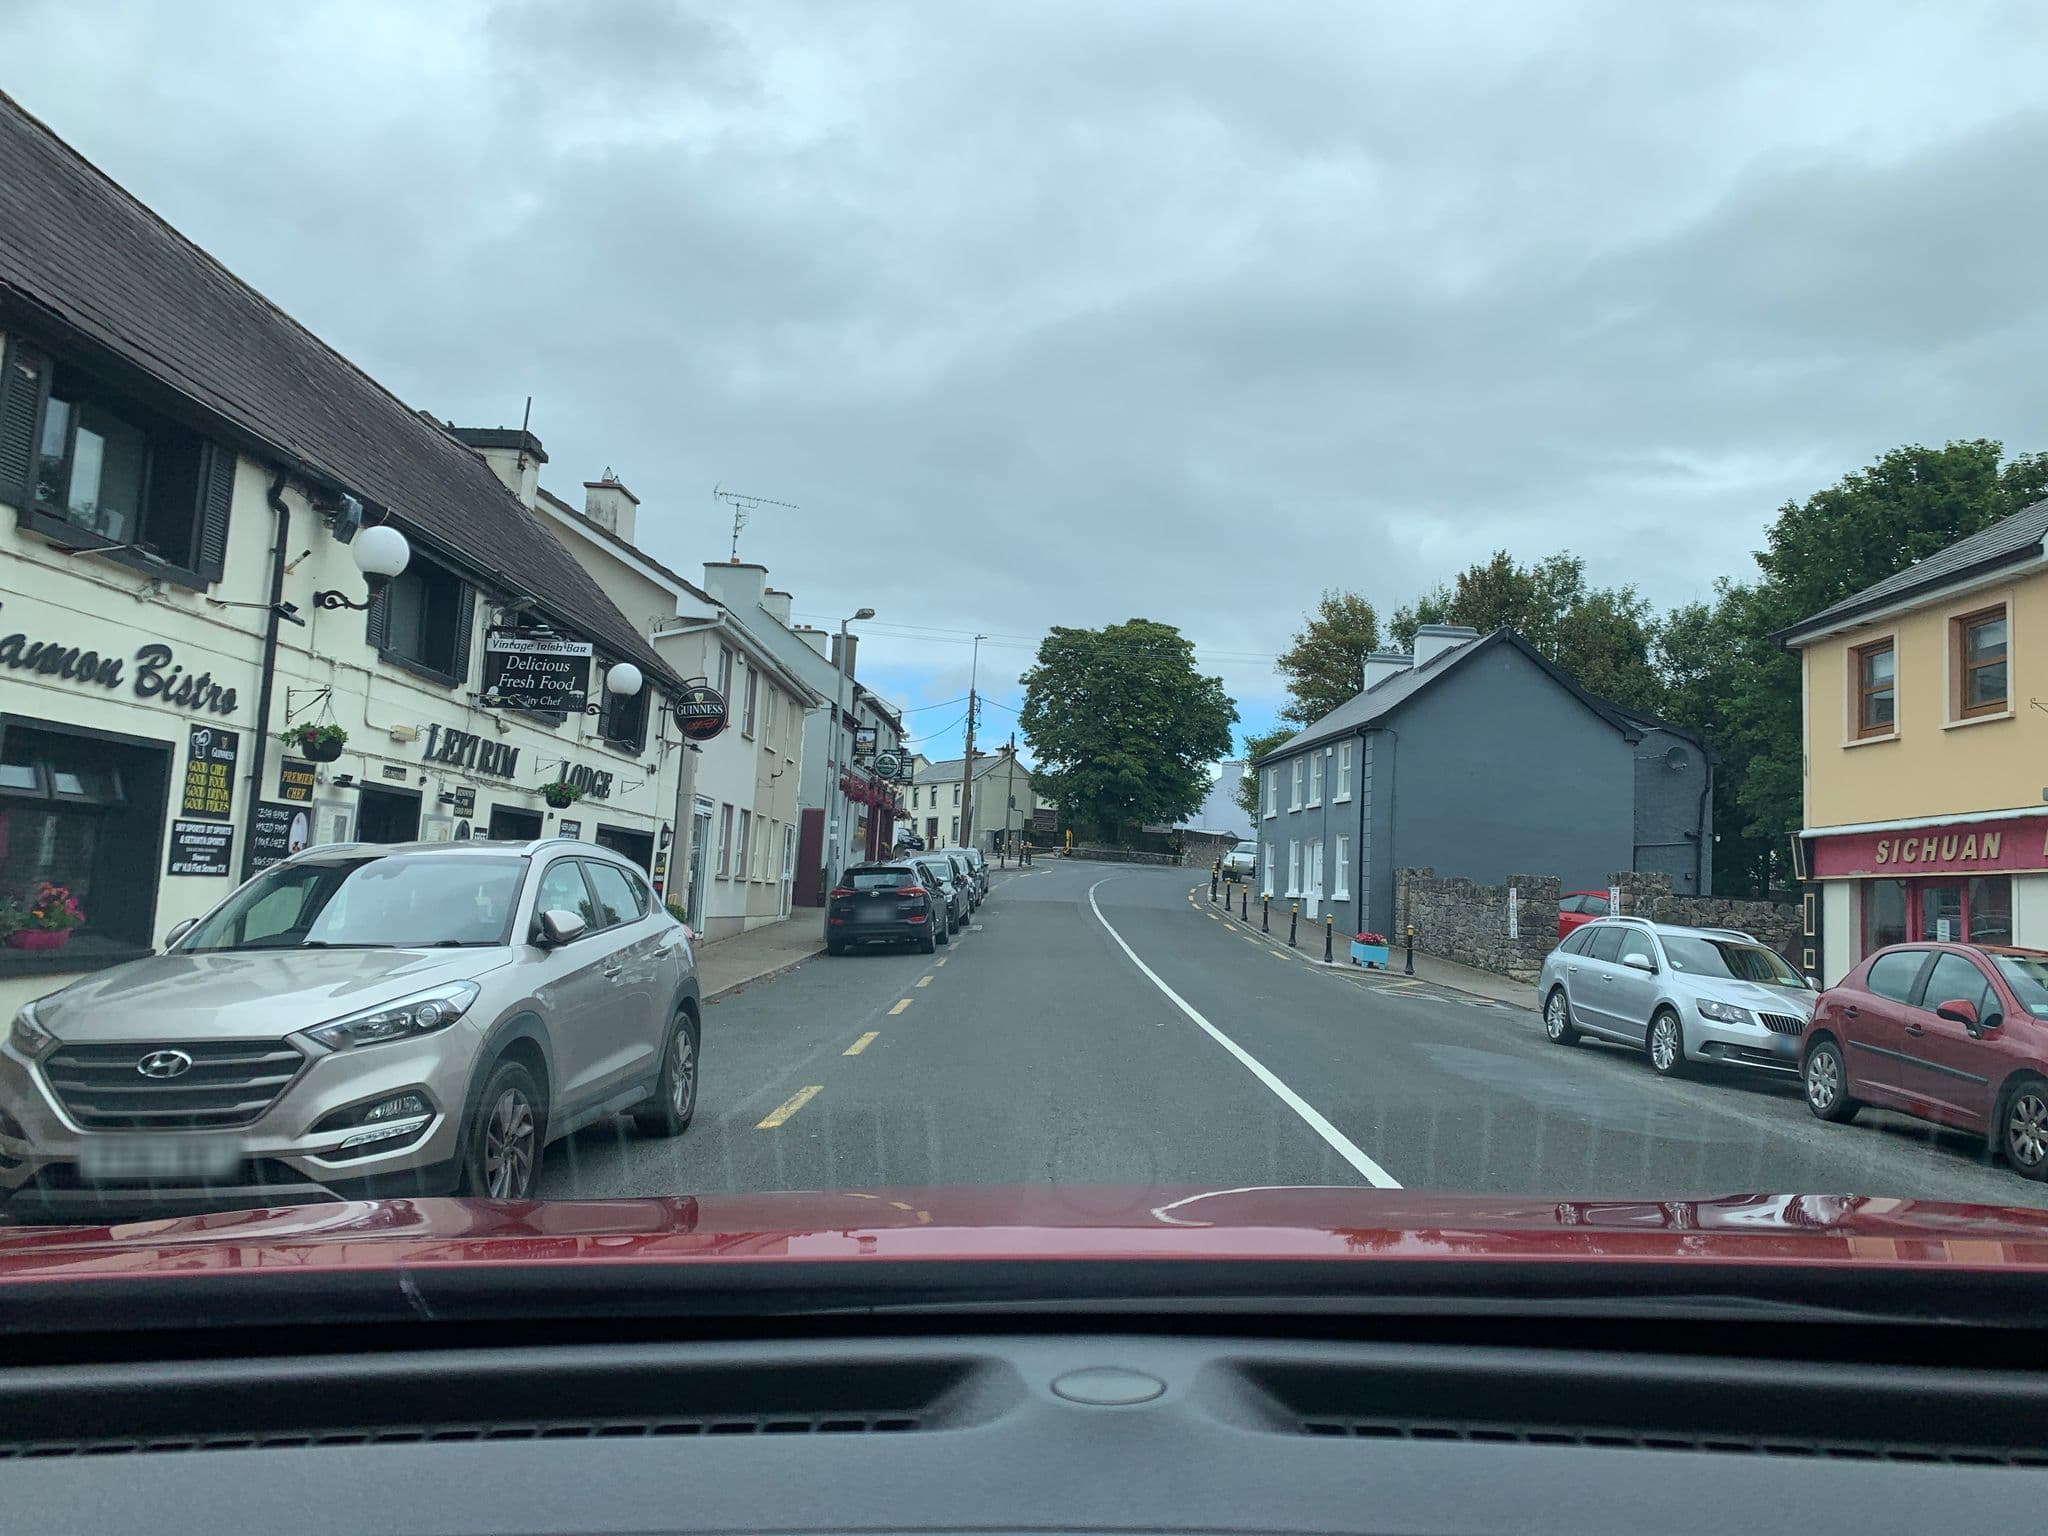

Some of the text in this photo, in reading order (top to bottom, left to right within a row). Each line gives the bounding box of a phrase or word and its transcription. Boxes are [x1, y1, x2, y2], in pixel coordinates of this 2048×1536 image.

[492, 640, 534, 653] Vintage
[536, 642, 563, 653] Irish
[506, 655, 570, 673] Delicious
[0, 632, 240, 715] annon Bistro
[499, 674, 576, 691] Fresh Food
[540, 695, 563, 706] Chef
[676, 704, 724, 716] GUINNESS
[423, 722, 521, 779] LEITRIM
[188, 761, 228, 777] GOOD CHEF
[187, 773, 226, 788] GOOD FOOD
[282, 771, 314, 786] PREMIER
[558, 760, 614, 799] LODGE
[185, 785, 206, 798] GOOD
[286, 787, 307, 800] CHEF
[184, 797, 204, 810] GOOD
[1874, 831, 2002, 865] SICHUAN
